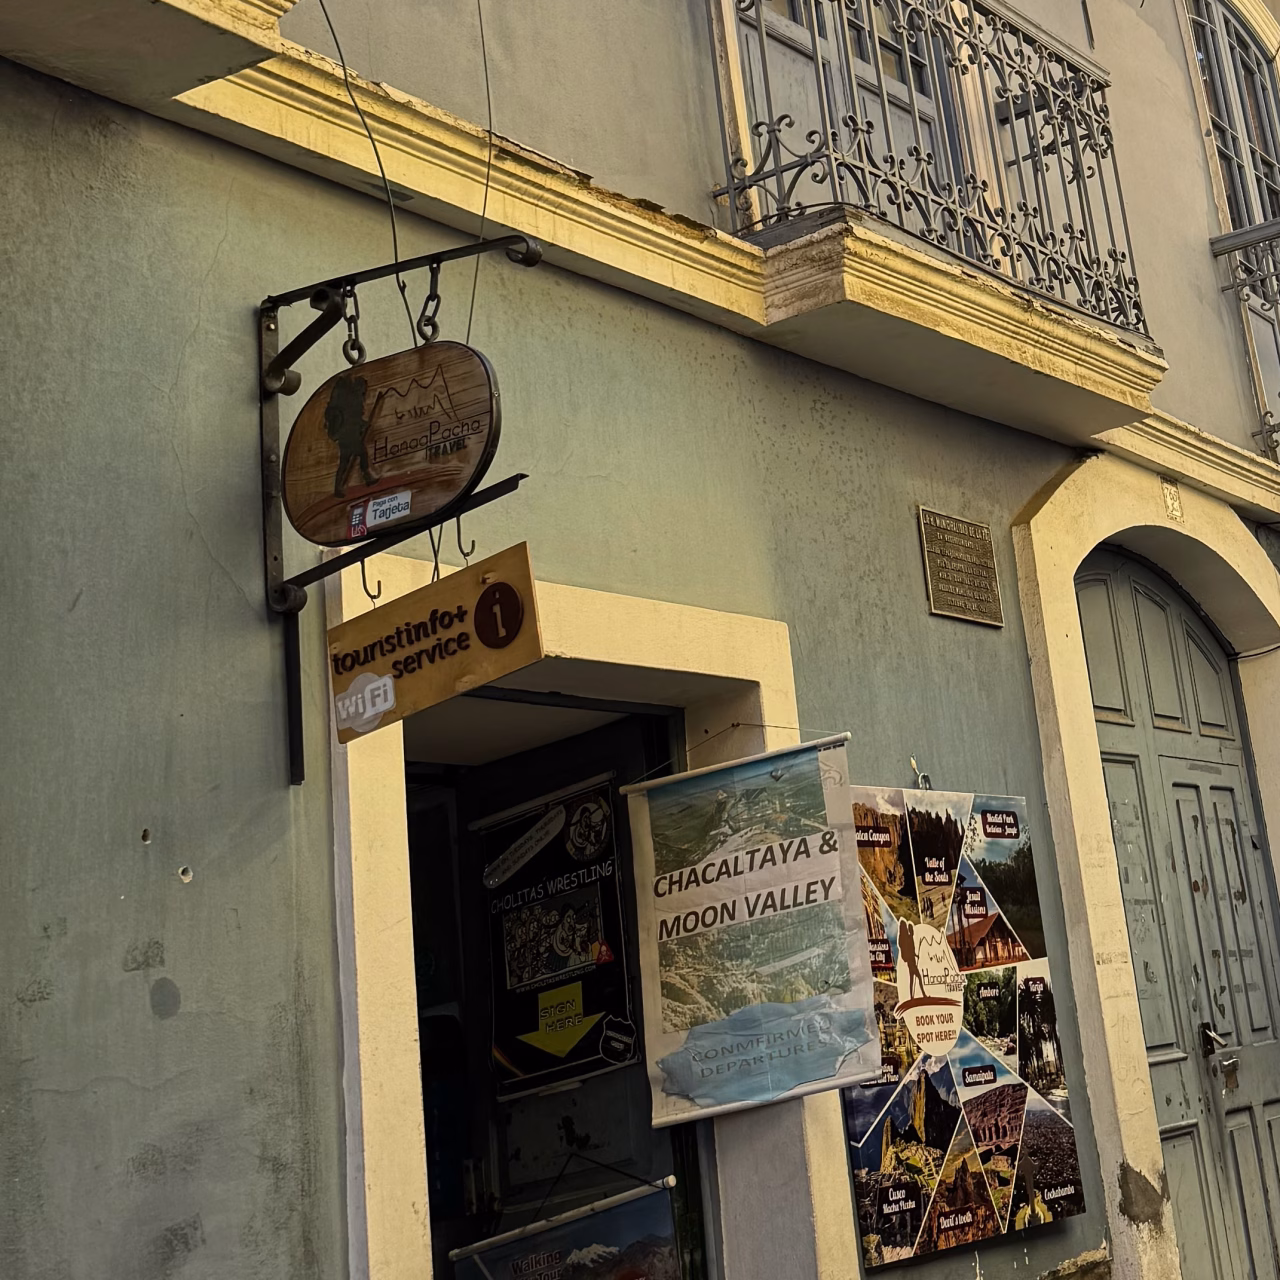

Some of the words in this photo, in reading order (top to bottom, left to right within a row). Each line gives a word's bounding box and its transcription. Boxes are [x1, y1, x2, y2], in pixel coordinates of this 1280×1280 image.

[427, 437, 467, 457] TRAVEL
[372, 498, 387, 508] Paga
[387, 495, 398, 505] con
[372, 499, 410, 520] Tarjeta
[391, 630, 471, 680] service
[653, 837, 811, 898] CHACALTAYA
[818, 830, 839, 855] &
[939, 856, 946, 871] of
[546, 860, 613, 896] WRESTLING
[925, 871, 934, 882] the
[934, 870, 949, 882] Souls
[658, 900, 736, 942] MOON
[742, 875, 836, 919] VALLEY
[964, 903, 986, 915] Missions
[540, 1000, 577, 1020] SIGN
[915, 1014, 935, 1026] BOOK
[935, 1012, 954, 1025] YOUR
[545, 1014, 583, 1034] HERE
[916, 1032, 934, 1044] SPOT
[700, 1039, 828, 1078] DEPARTURES
[888, 1187, 906, 1200] Cusco
[511, 1249, 562, 1275] Walking
